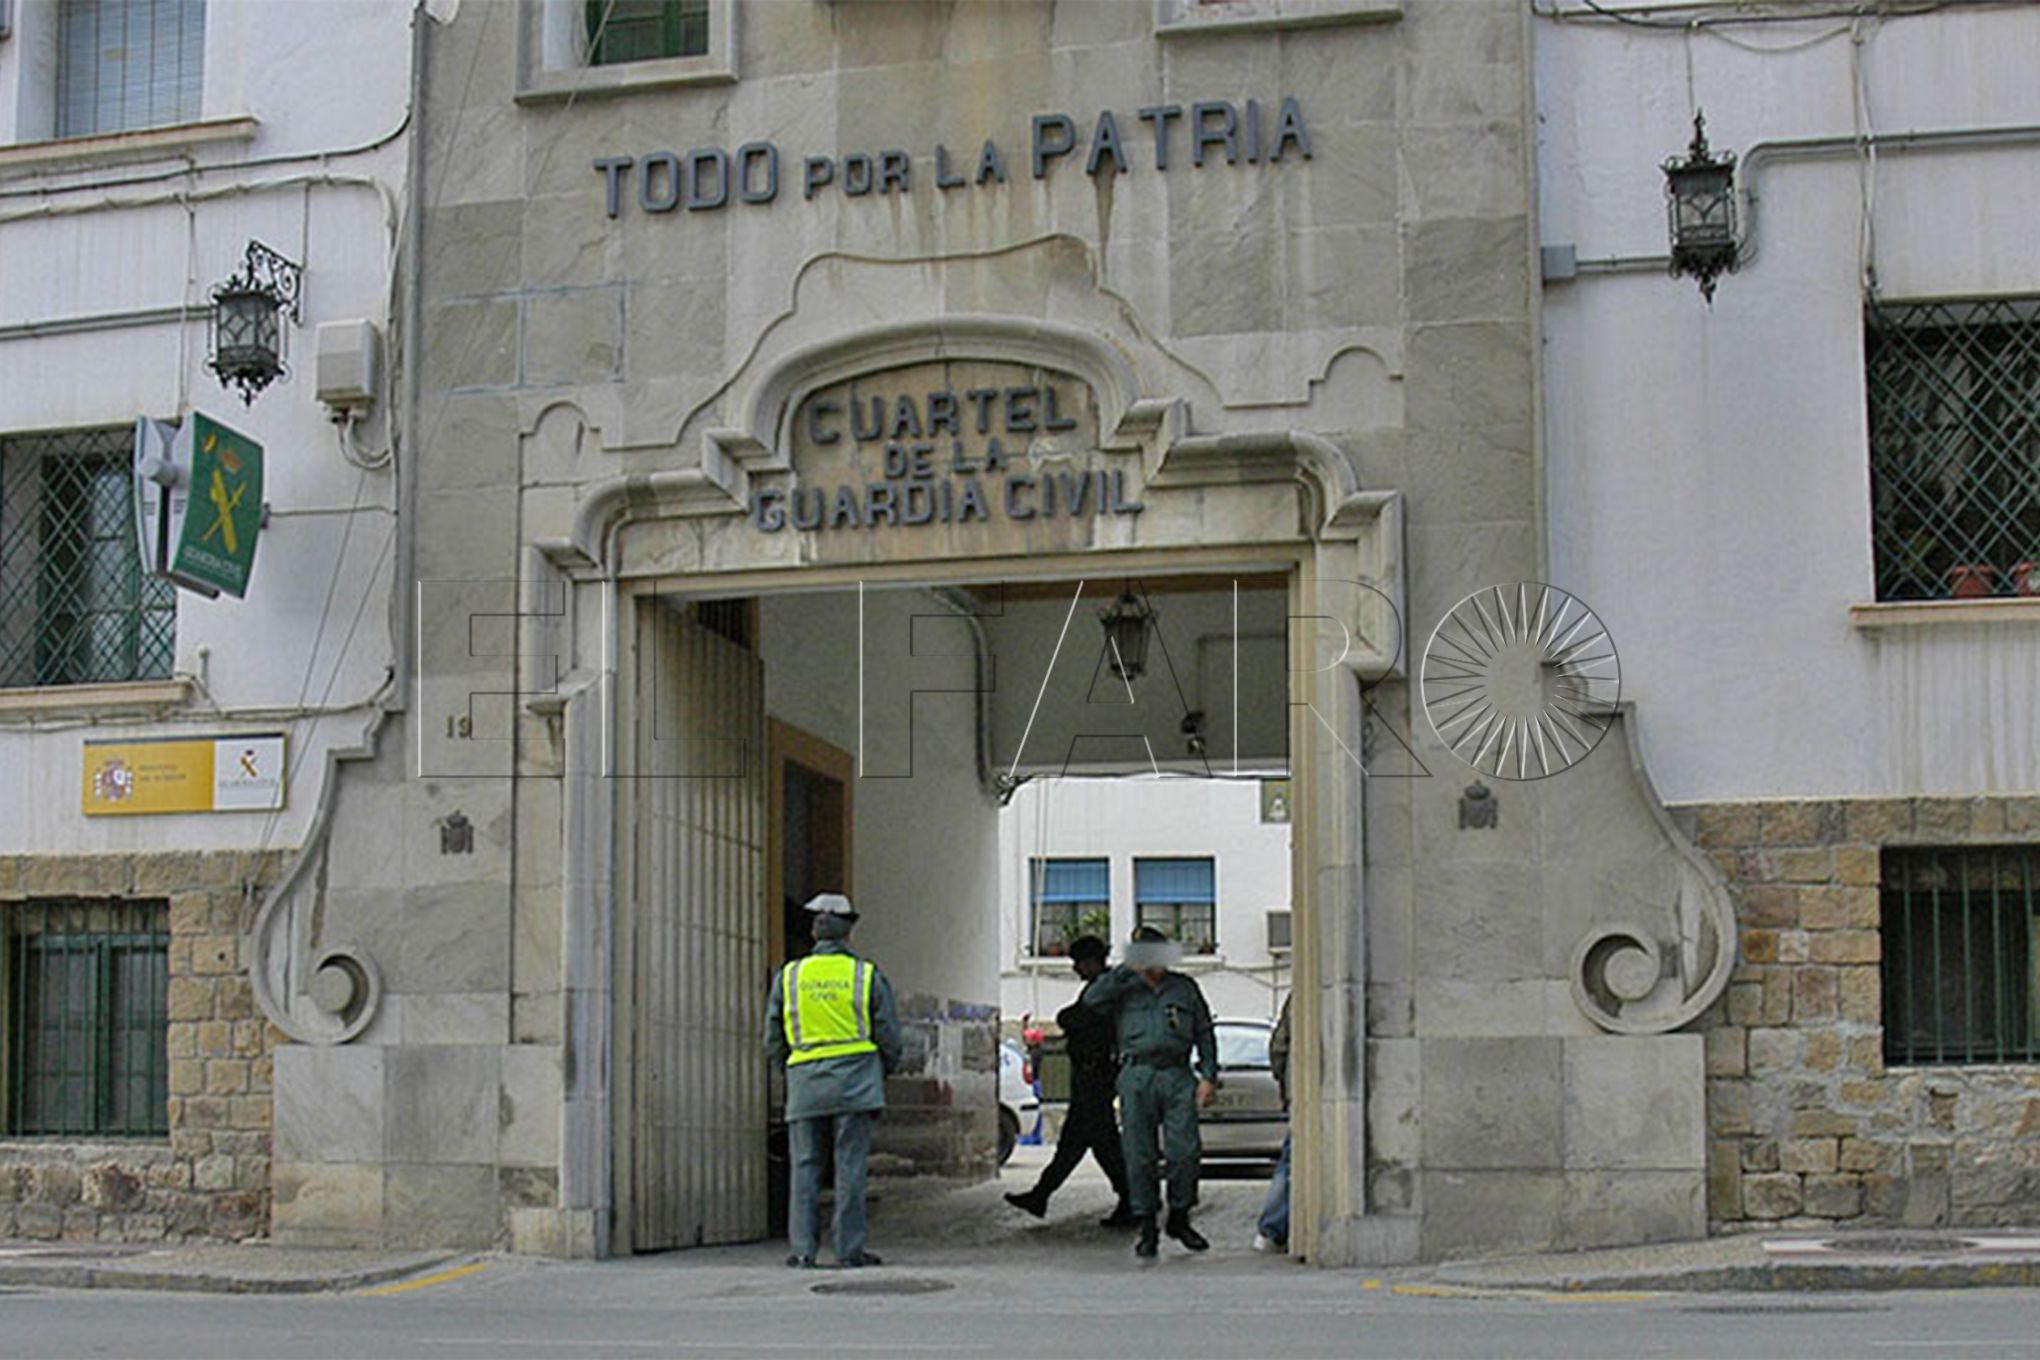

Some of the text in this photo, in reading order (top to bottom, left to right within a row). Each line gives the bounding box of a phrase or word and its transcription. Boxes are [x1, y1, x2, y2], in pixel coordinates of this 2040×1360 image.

[593, 95, 1313, 219] TODO POR LA PATRIA
[807, 384, 1078, 445] CUARTEL
[884, 437, 1009, 480] DE LA
[753, 468, 1145, 532] GUARDIA CIVIL
